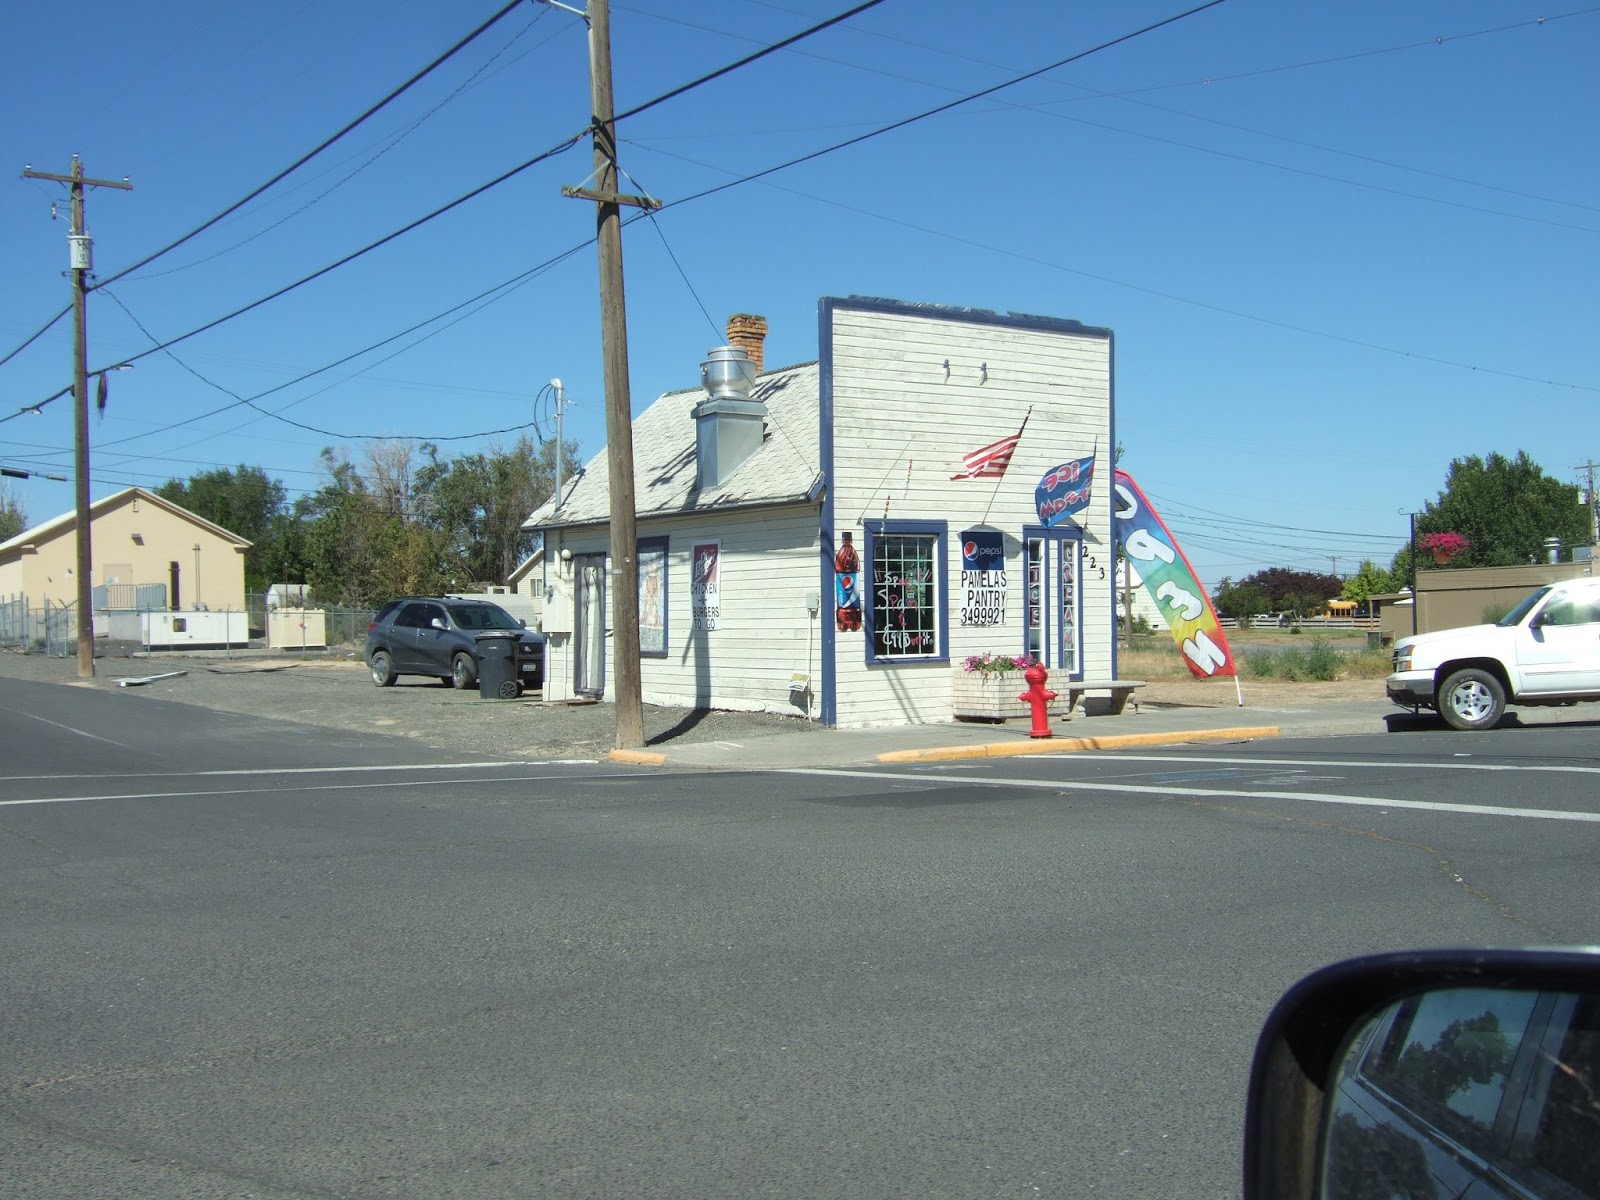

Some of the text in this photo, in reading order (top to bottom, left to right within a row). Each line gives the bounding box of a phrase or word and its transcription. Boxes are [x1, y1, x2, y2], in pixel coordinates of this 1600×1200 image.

[980, 546, 1002, 557] pepsi
[961, 570, 1007, 588] PAMELAS
[690, 583, 717, 595] CHICKEN
[967, 590, 1006, 607] PANTRY
[693, 606, 720, 618] BURGERS
[961, 607, 1006, 624] 3499921
[694, 618, 716, 630] TO GO
